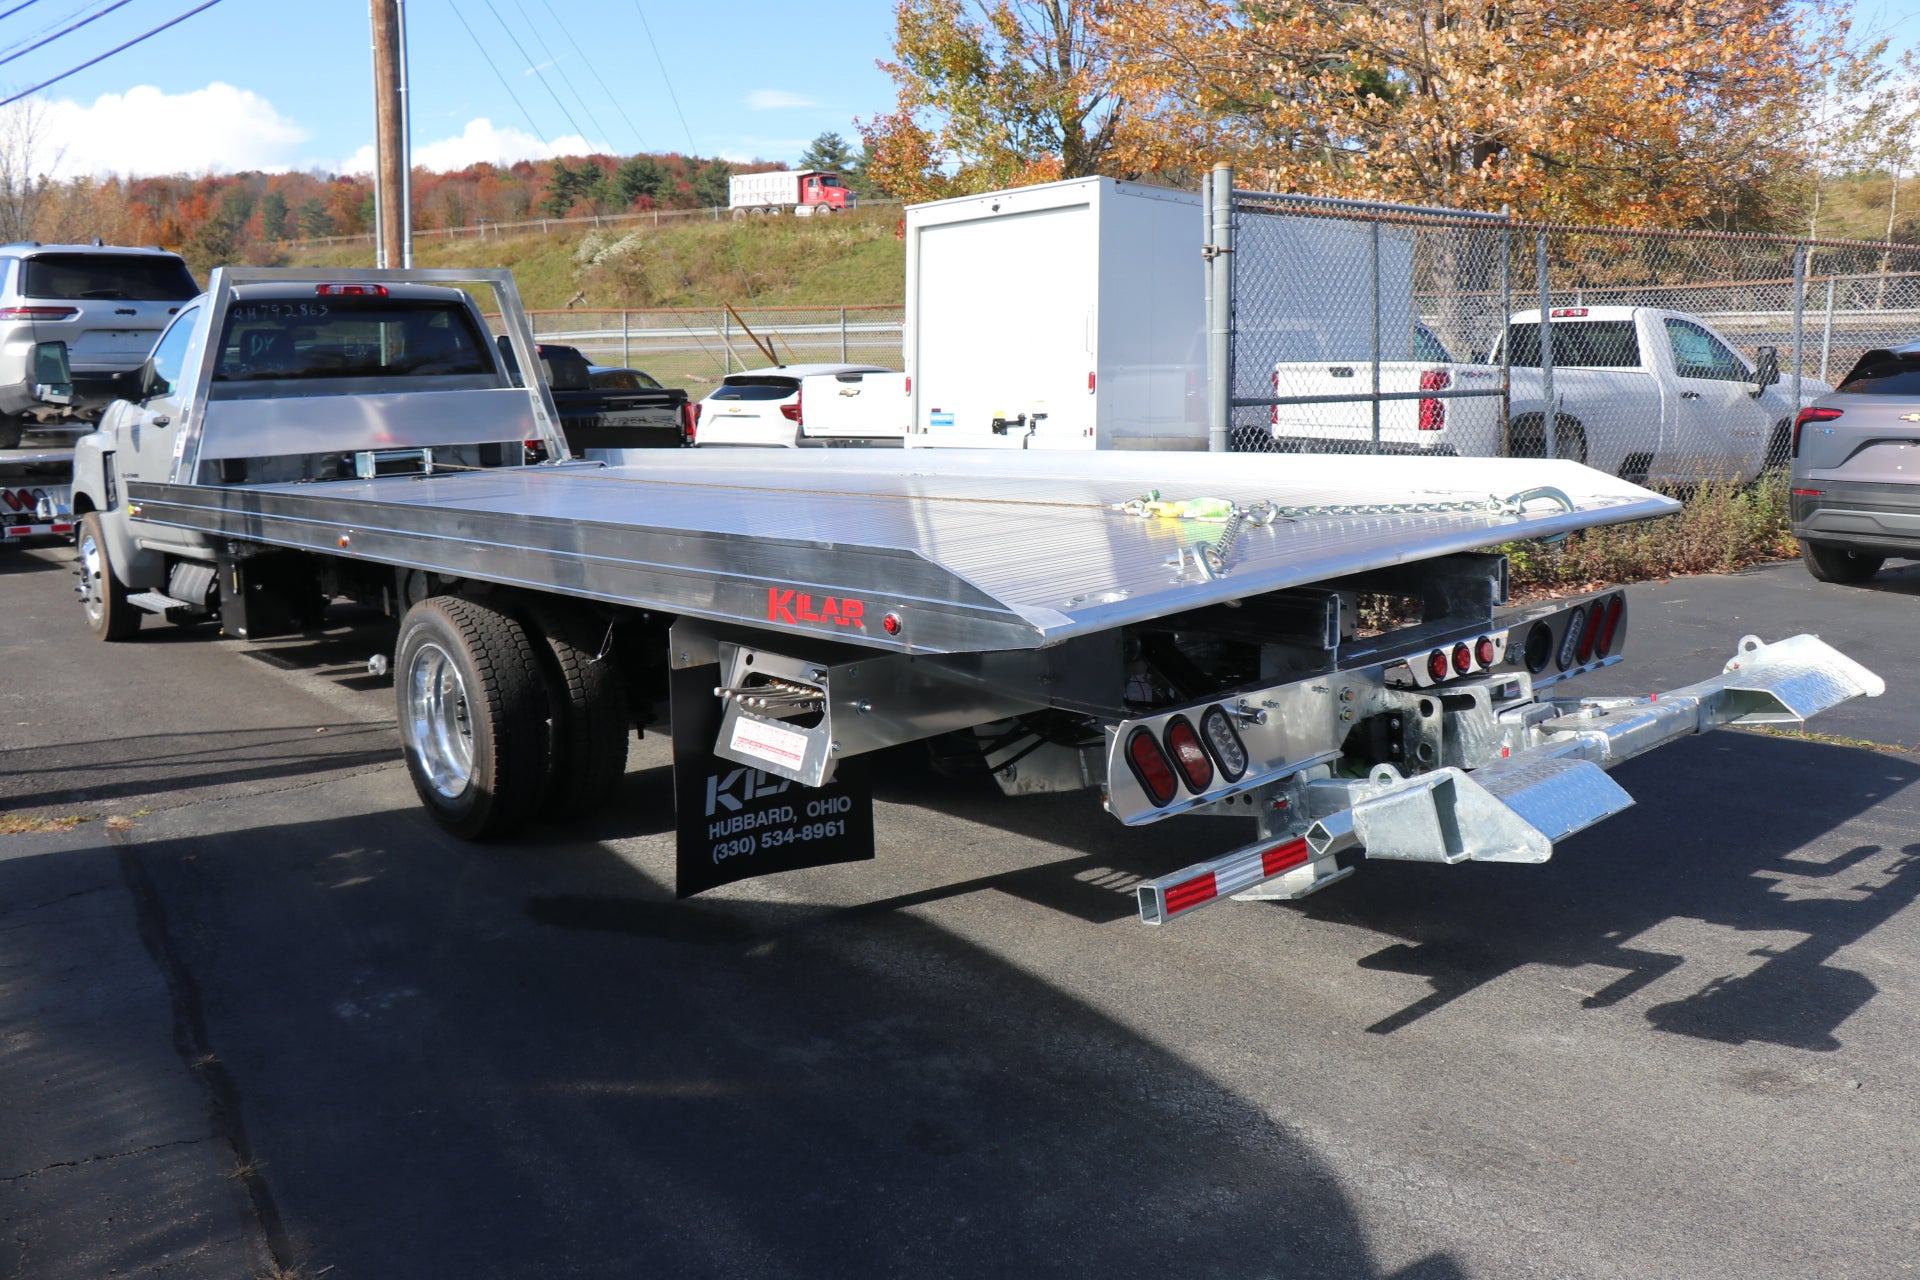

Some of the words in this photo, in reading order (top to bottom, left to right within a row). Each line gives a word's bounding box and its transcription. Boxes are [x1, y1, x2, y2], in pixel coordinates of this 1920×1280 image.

[767, 587, 866, 628] KILAR
[705, 767, 838, 817] KIL
[708, 806, 798, 840] HUBBARD,
[806, 795, 851, 817] OHIO
[712, 835, 756, 864] (330)
[760, 819, 845, 848] 534-8961
